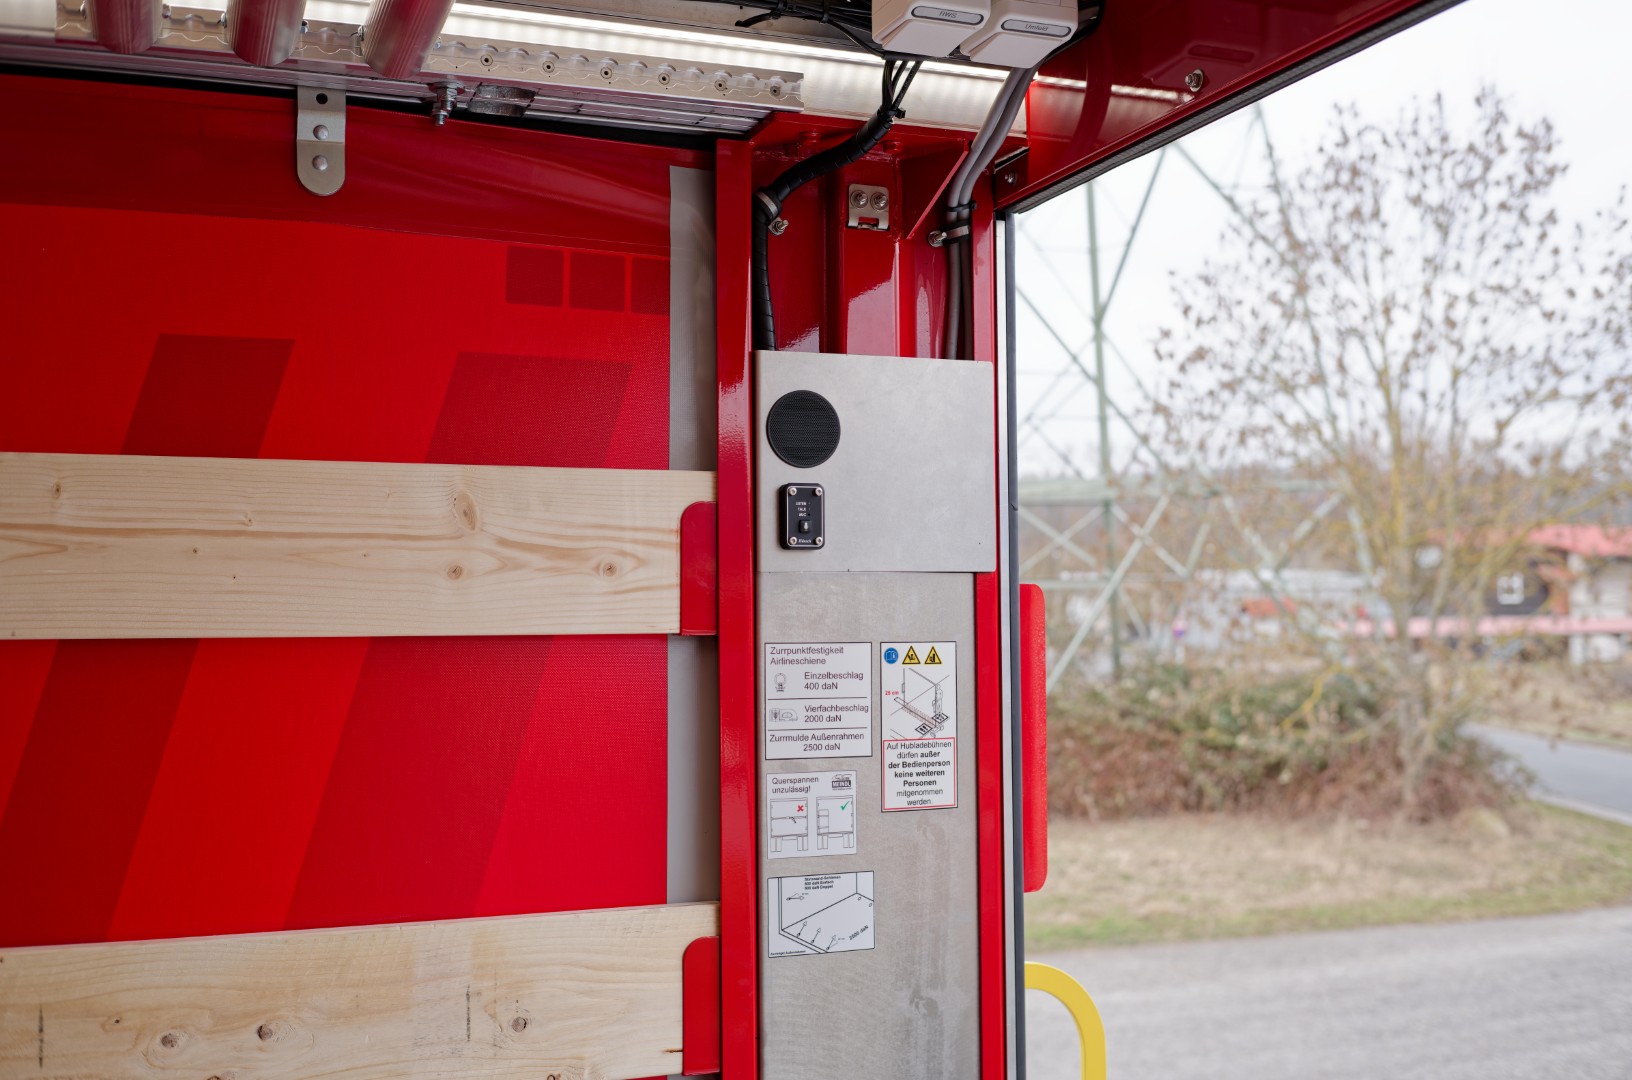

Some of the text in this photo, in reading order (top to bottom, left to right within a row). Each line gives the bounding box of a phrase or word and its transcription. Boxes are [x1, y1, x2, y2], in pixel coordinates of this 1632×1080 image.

[1024, 23, 1048, 32] Umfeld
[770, 646, 844, 655] Zurrpunktfestigkeit
[770, 657, 826, 665] Airlineschiene
[804, 672, 864, 680] Einzelbeschlag
[804, 704, 869, 713] Vierfachbeschlag
[770, 733, 864, 742] Zurrmulde Außenrahmen
[900, 741, 952, 749] Hubladebühnen
[902, 760, 950, 768] Bedienperson
[772, 776, 819, 785] Querspannen
[896, 789, 943, 797] mitgenommen
